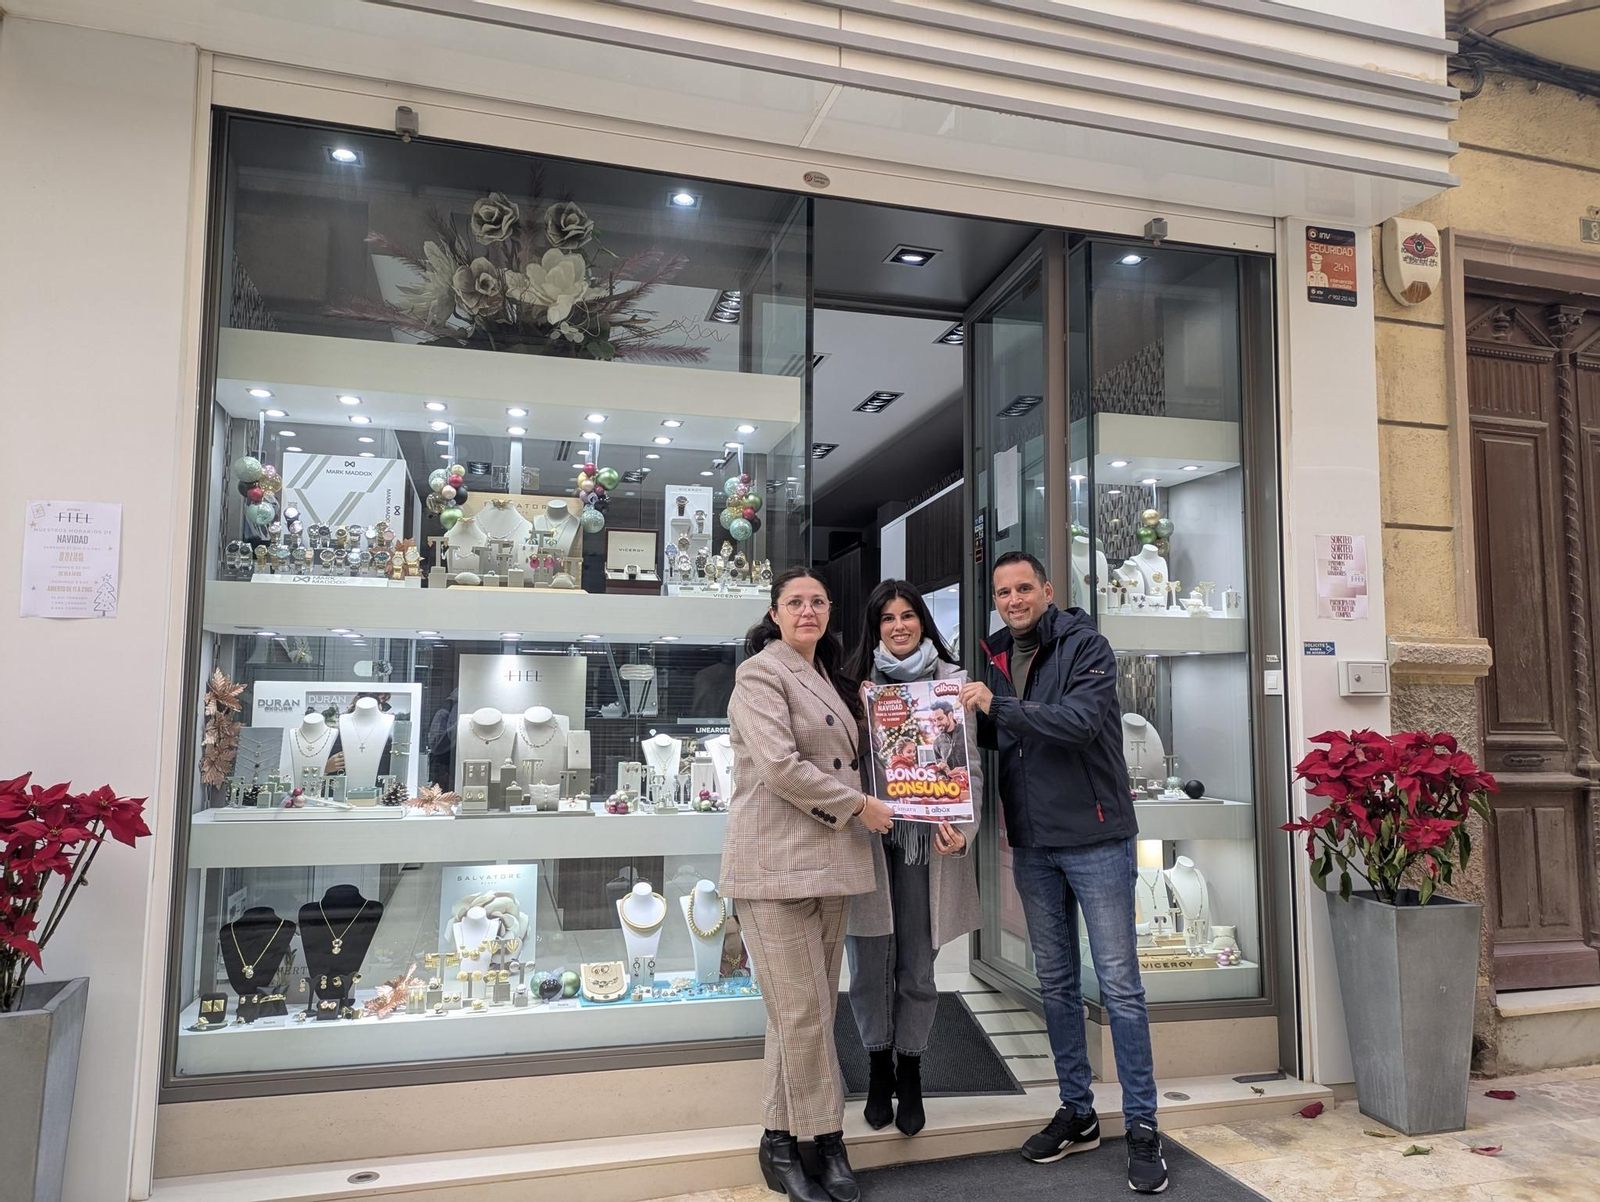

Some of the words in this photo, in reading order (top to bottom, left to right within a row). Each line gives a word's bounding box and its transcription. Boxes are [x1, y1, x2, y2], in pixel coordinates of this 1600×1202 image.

[1309, 243, 1354, 257] SEGURIDAD
[1333, 262, 1350, 273] 24h
[56, 534, 89, 545] NAVIDAD
[1330, 535, 1353, 545] SORTEO
[1330, 544, 1353, 553] SORTEO
[934, 682, 959, 693] albox
[257, 699, 300, 707] DURAN
[308, 694, 346, 704] DURAN
[877, 703, 903, 712] NAVIDAD
[885, 767, 937, 782] BONOS
[886, 779, 961, 798] CONSUMO
[931, 806, 951, 814] albox
[457, 873, 522, 882] SALVATORE
[1141, 961, 1194, 969] VICEROY
